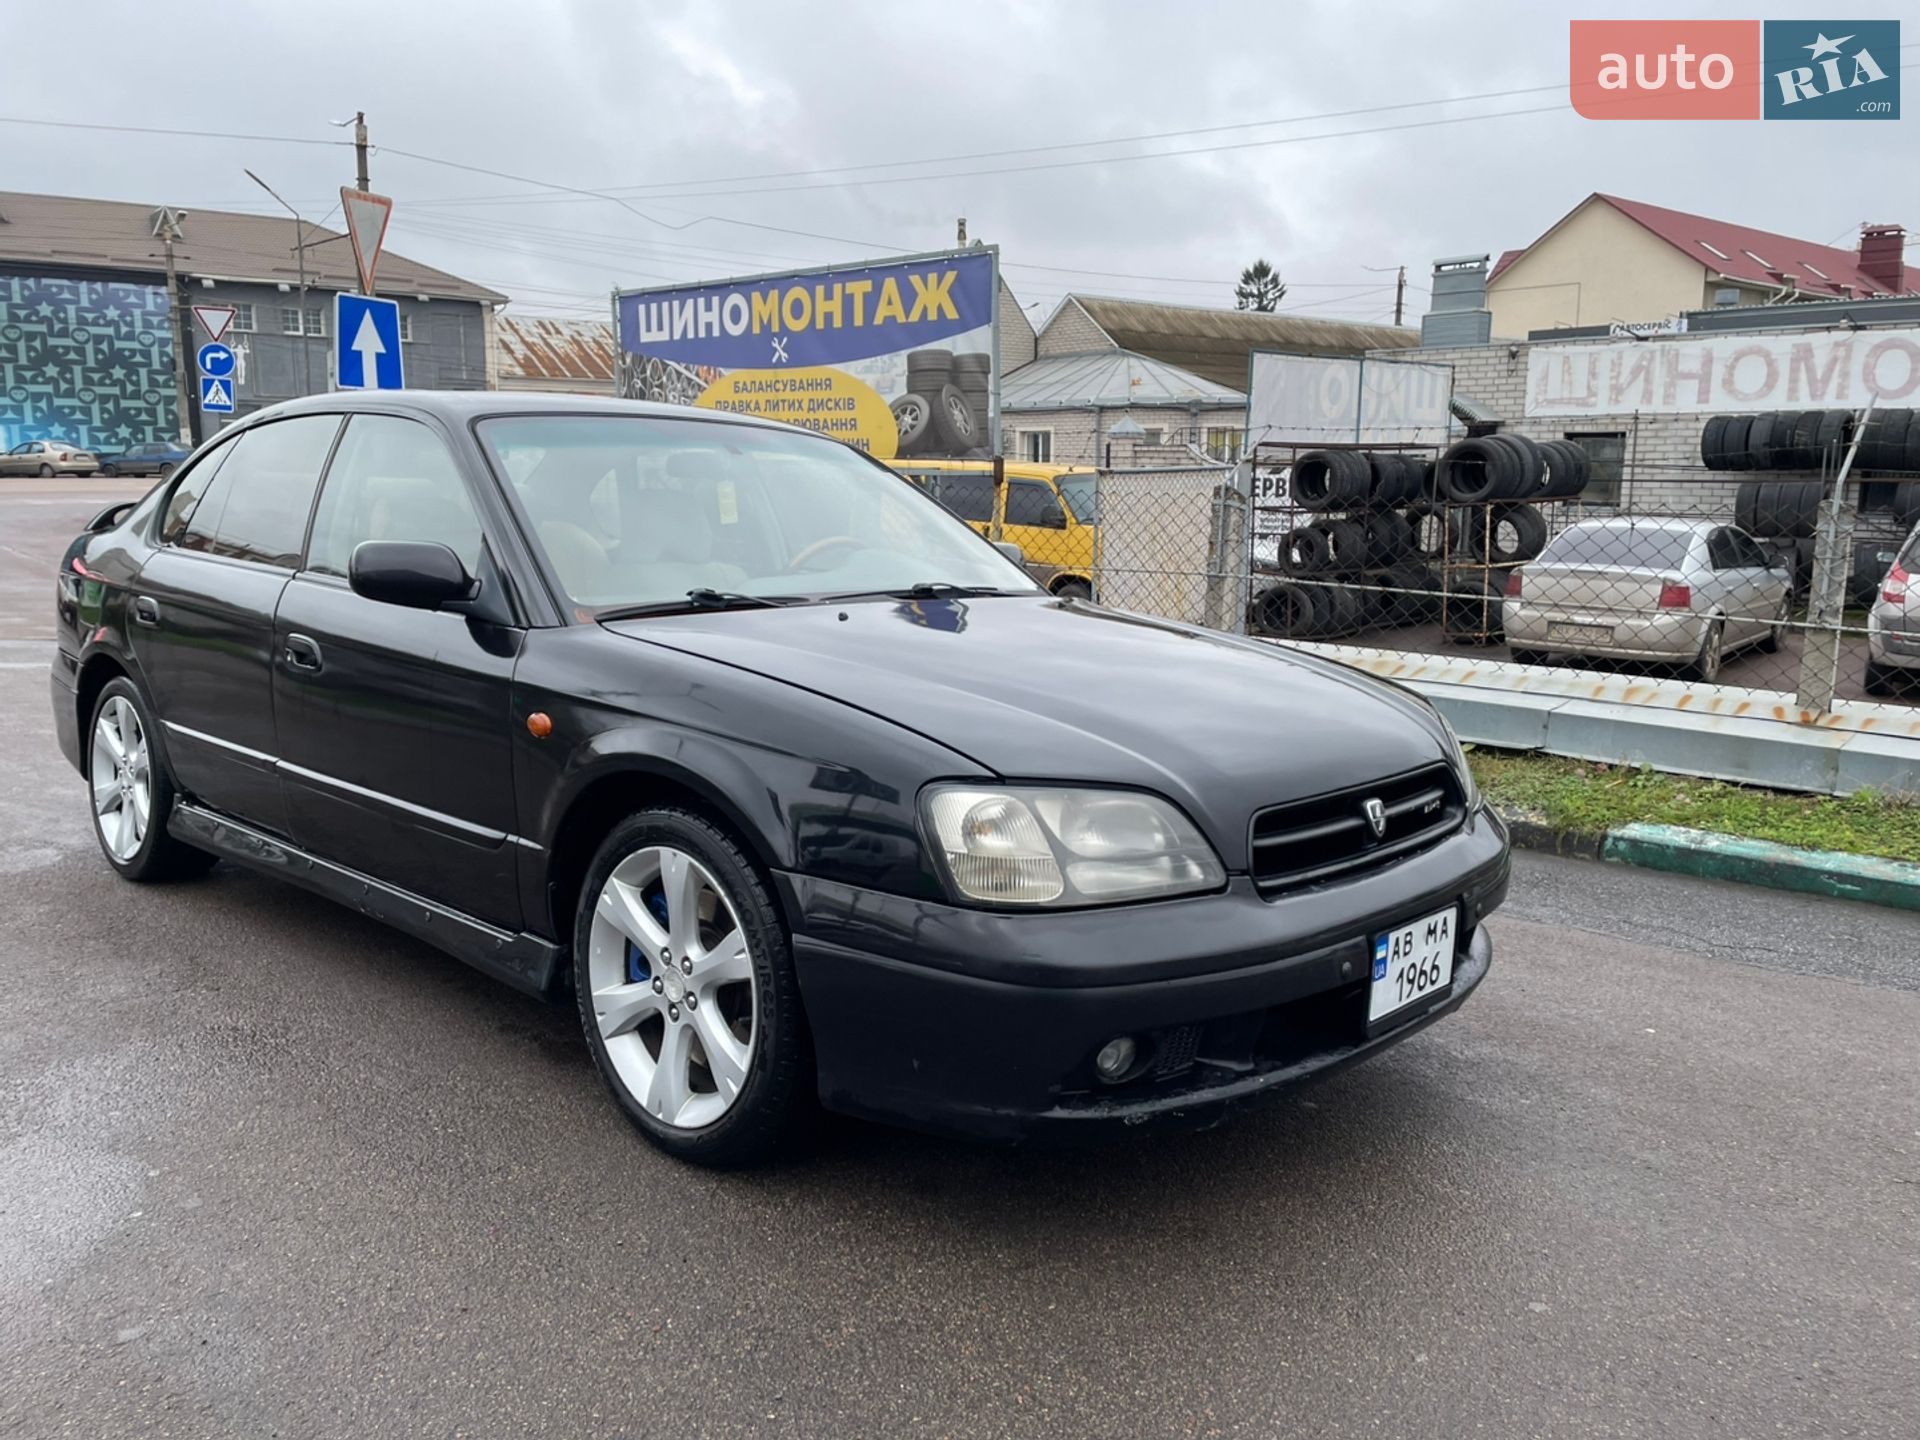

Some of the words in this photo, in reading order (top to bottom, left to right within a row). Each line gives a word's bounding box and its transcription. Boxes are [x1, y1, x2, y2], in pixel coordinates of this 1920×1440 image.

[638, 270, 960, 343] ШИНОМОНТАЖ
[733, 377, 833, 394] БАЛАНСУВАННЯ
[715, 399, 761, 413] ПРАВКА
[764, 398, 804, 412] ЛИТИХ
[807, 397, 856, 413] ДИСКІВ
[1391, 931, 1413, 962] AB
[1425, 916, 1448, 945] MA
[1374, 963, 1386, 979] UA
[1395, 951, 1441, 1002] 1966
